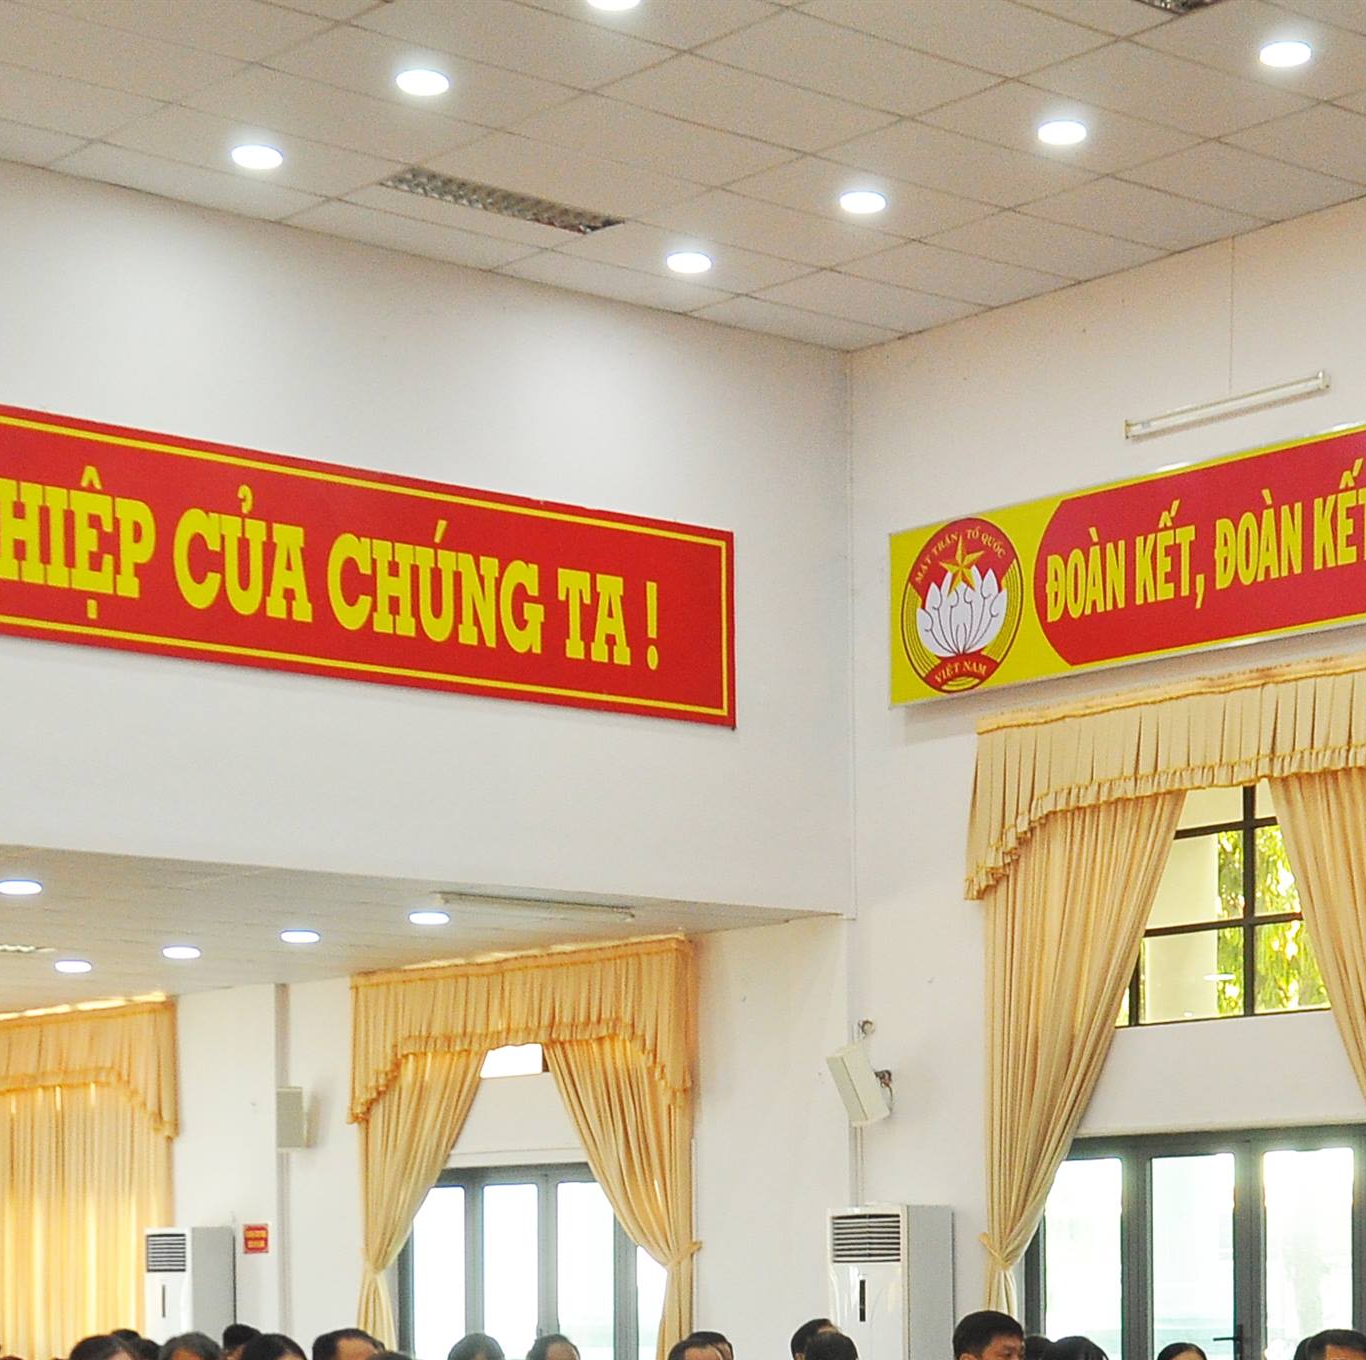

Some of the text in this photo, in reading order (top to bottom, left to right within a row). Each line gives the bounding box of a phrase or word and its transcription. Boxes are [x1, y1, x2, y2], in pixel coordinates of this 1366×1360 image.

[172, 484, 313, 623] CỦA
[326, 519, 545, 659] CHÚNG
[1045, 527, 1127, 623] ĐOÀN
[1135, 499, 1206, 609] KẾT,
[1213, 488, 1303, 591] ĐOÀN
[963, 661, 987, 676] NAM
